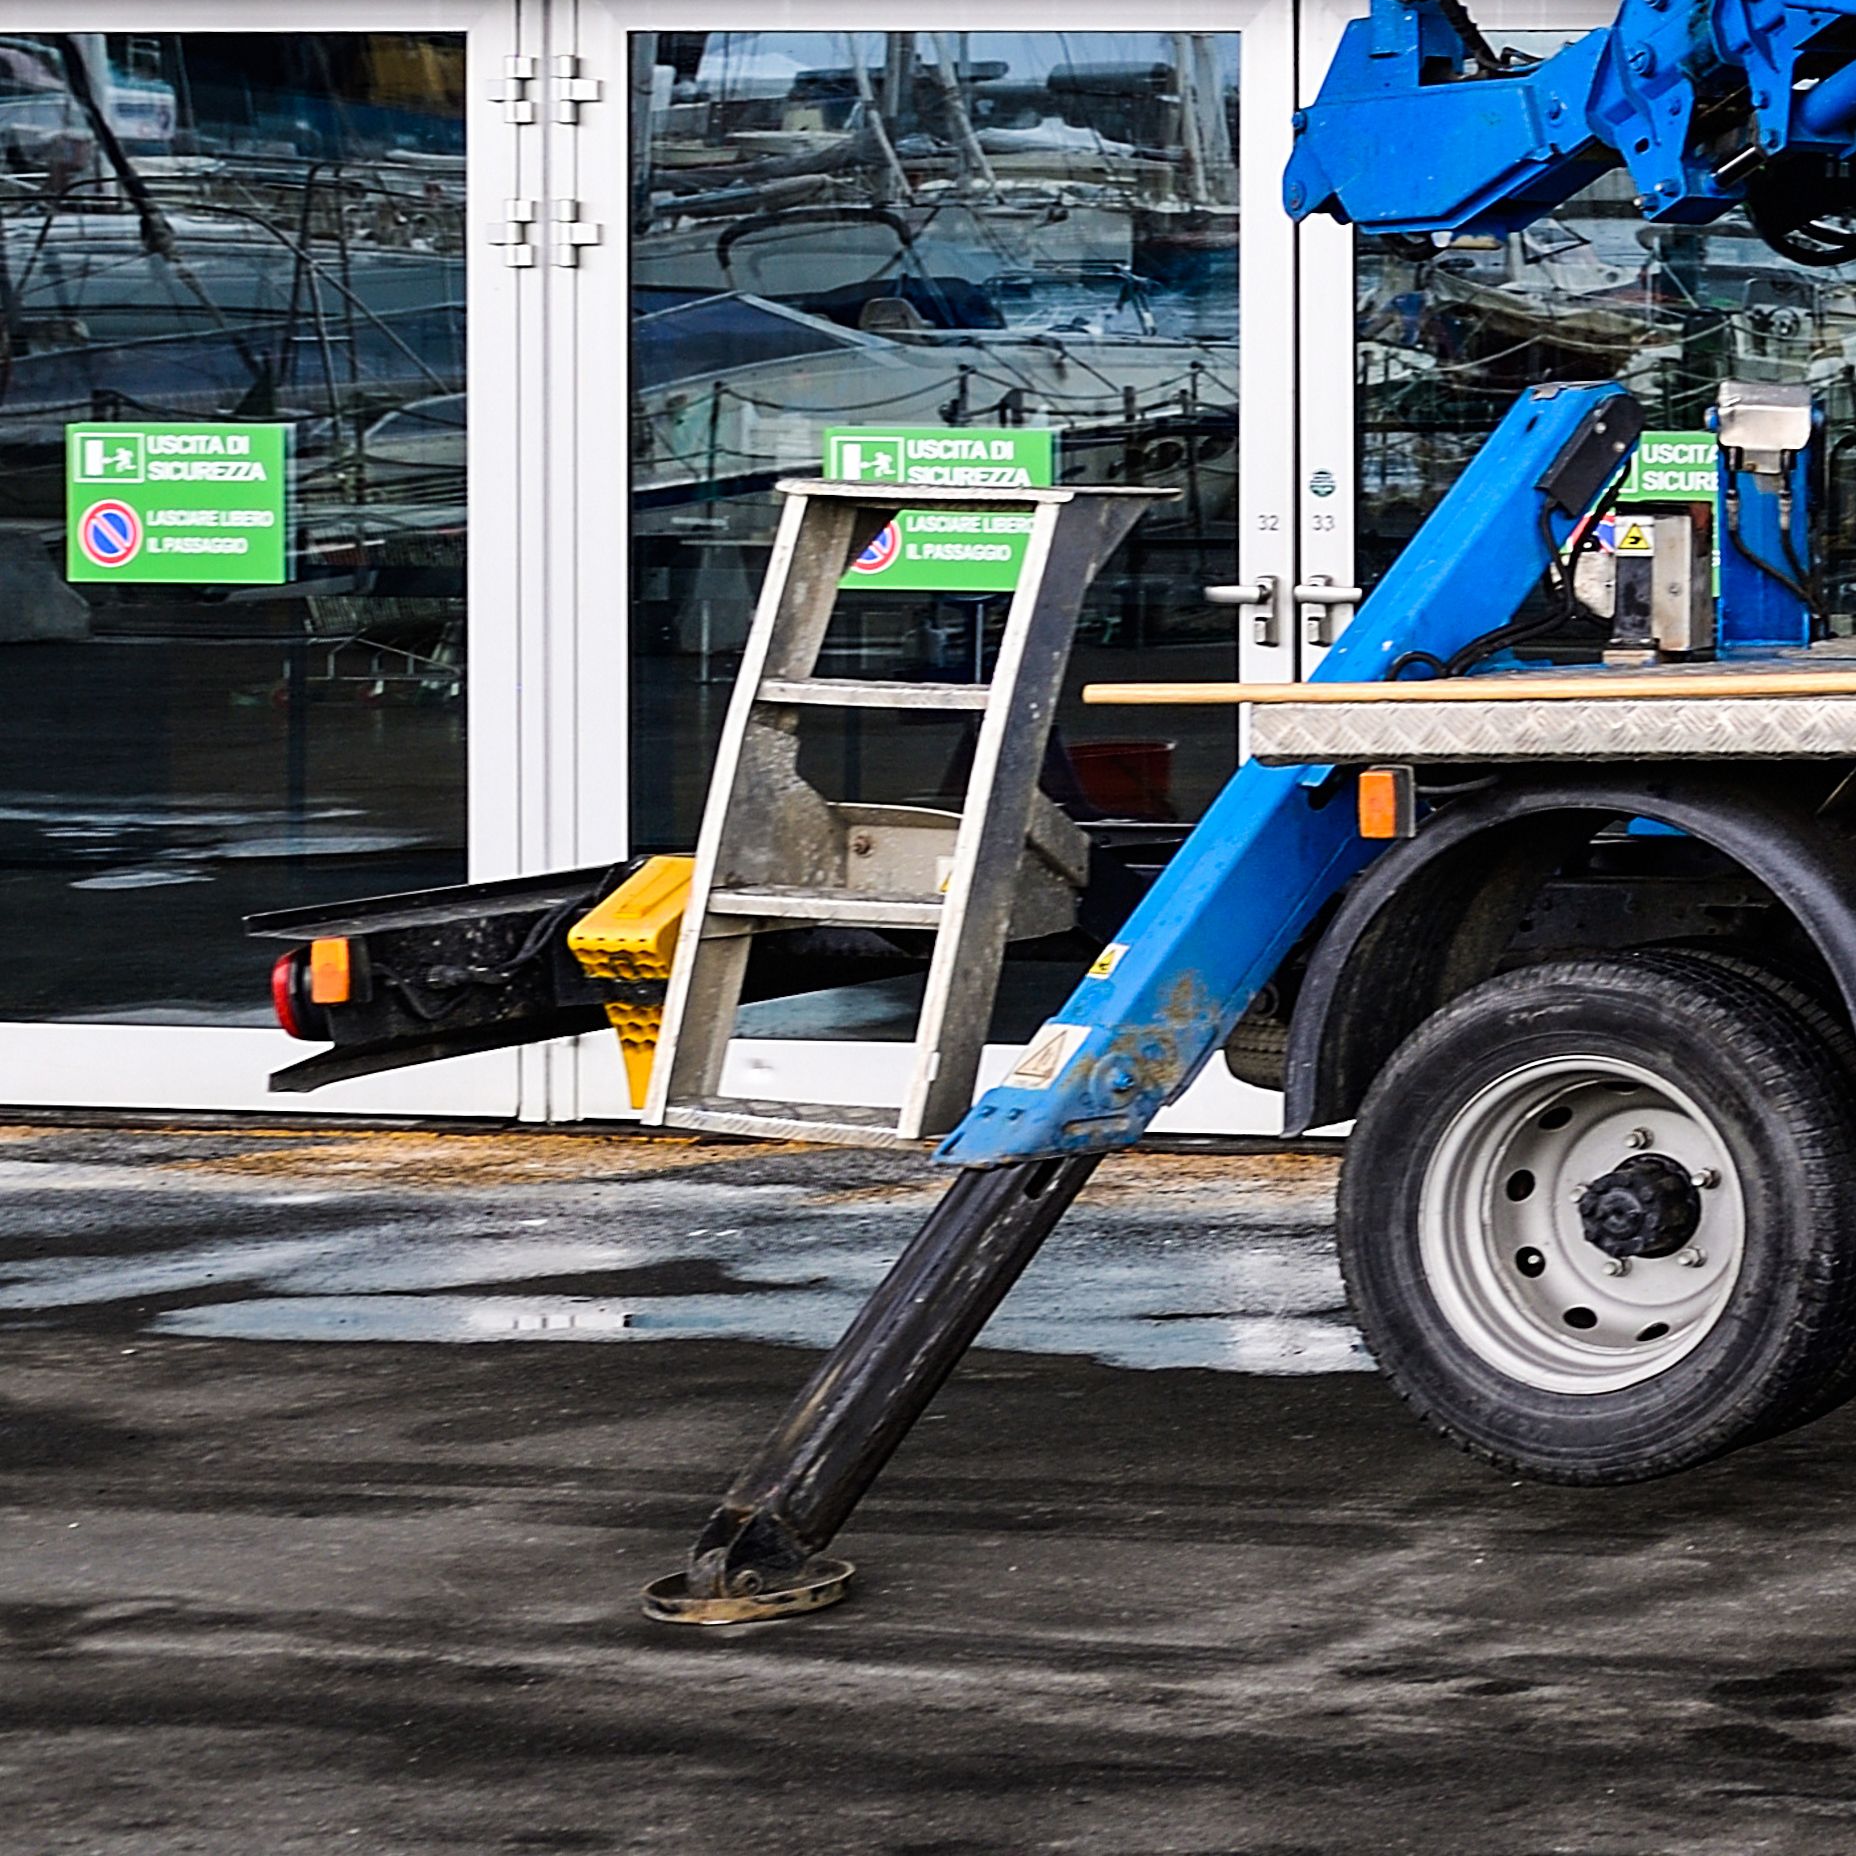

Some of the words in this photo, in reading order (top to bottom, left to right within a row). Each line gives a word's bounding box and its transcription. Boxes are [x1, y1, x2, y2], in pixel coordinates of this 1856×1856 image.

[147, 435, 222, 455] USCITA
[226, 435, 250, 455] DI
[907, 440, 987, 460] USCITA
[991, 440, 1014, 460] DI
[1642, 443, 1719, 464] USCITA
[147, 461, 267, 481] SICUREZZA
[908, 467, 1031, 487] SICUREZZA
[146, 510, 219, 527] LASCIARE
[221, 510, 274, 527] LIBERO
[906, 516, 981, 533] LASCIARE
[1257, 514, 1280, 531] 32
[1311, 514, 1336, 532] 33
[161, 537, 248, 554] PASSAGGIO
[922, 544, 1012, 561] PASSAGGIO
